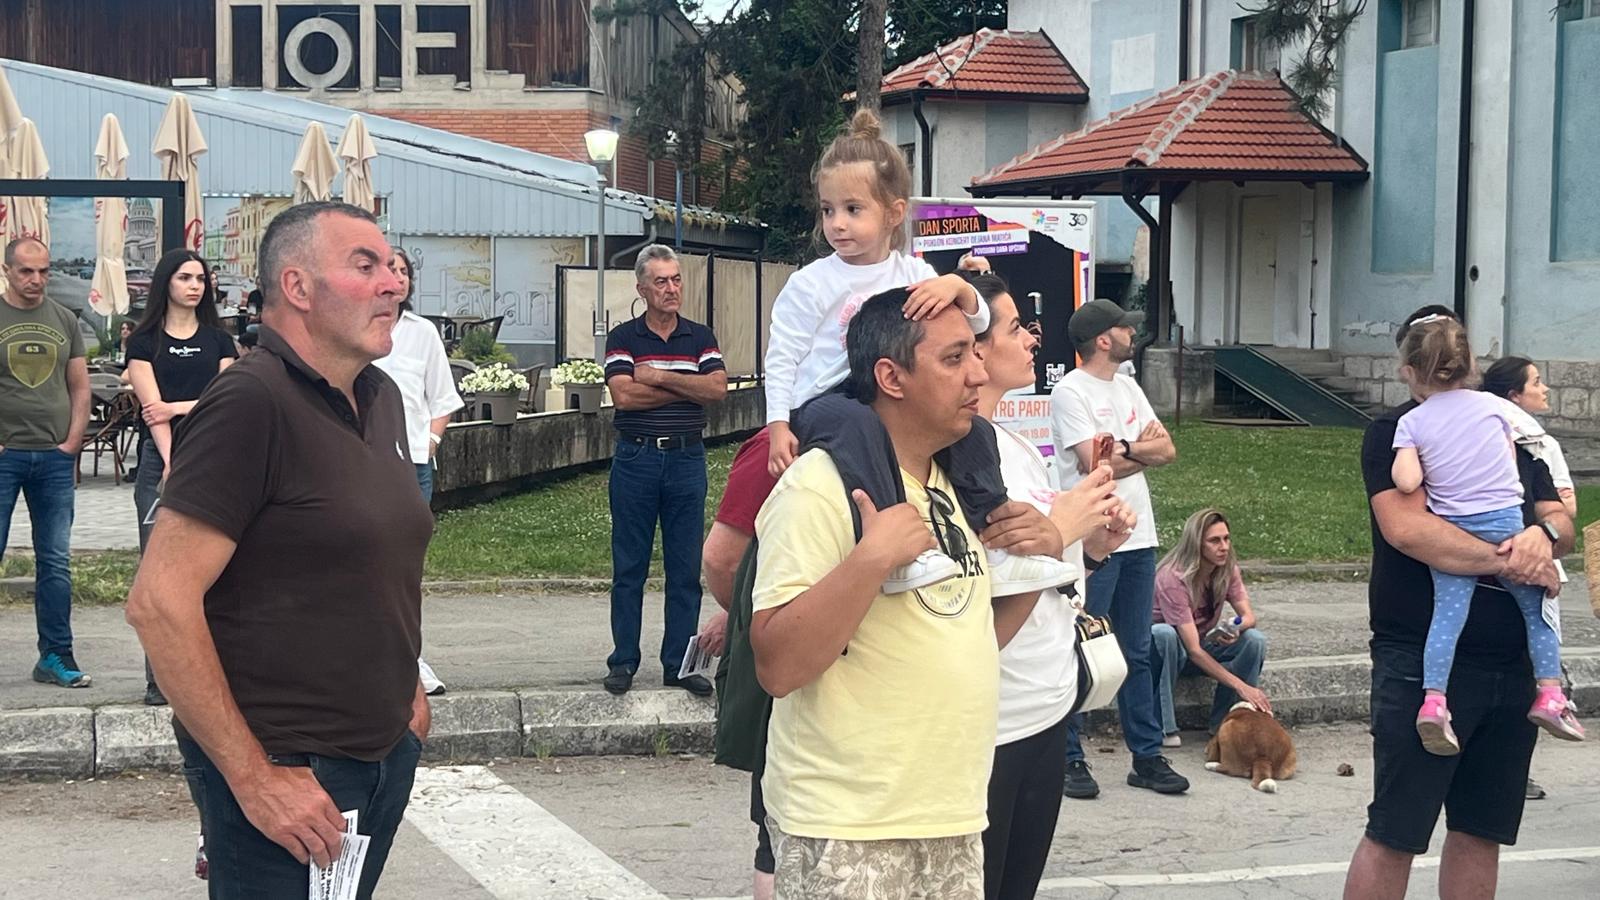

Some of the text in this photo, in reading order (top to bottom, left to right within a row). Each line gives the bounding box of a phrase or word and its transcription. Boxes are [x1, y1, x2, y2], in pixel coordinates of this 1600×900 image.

[920, 217, 980, 236] DAN SPORTA
[25, 345, 40, 354] 63
